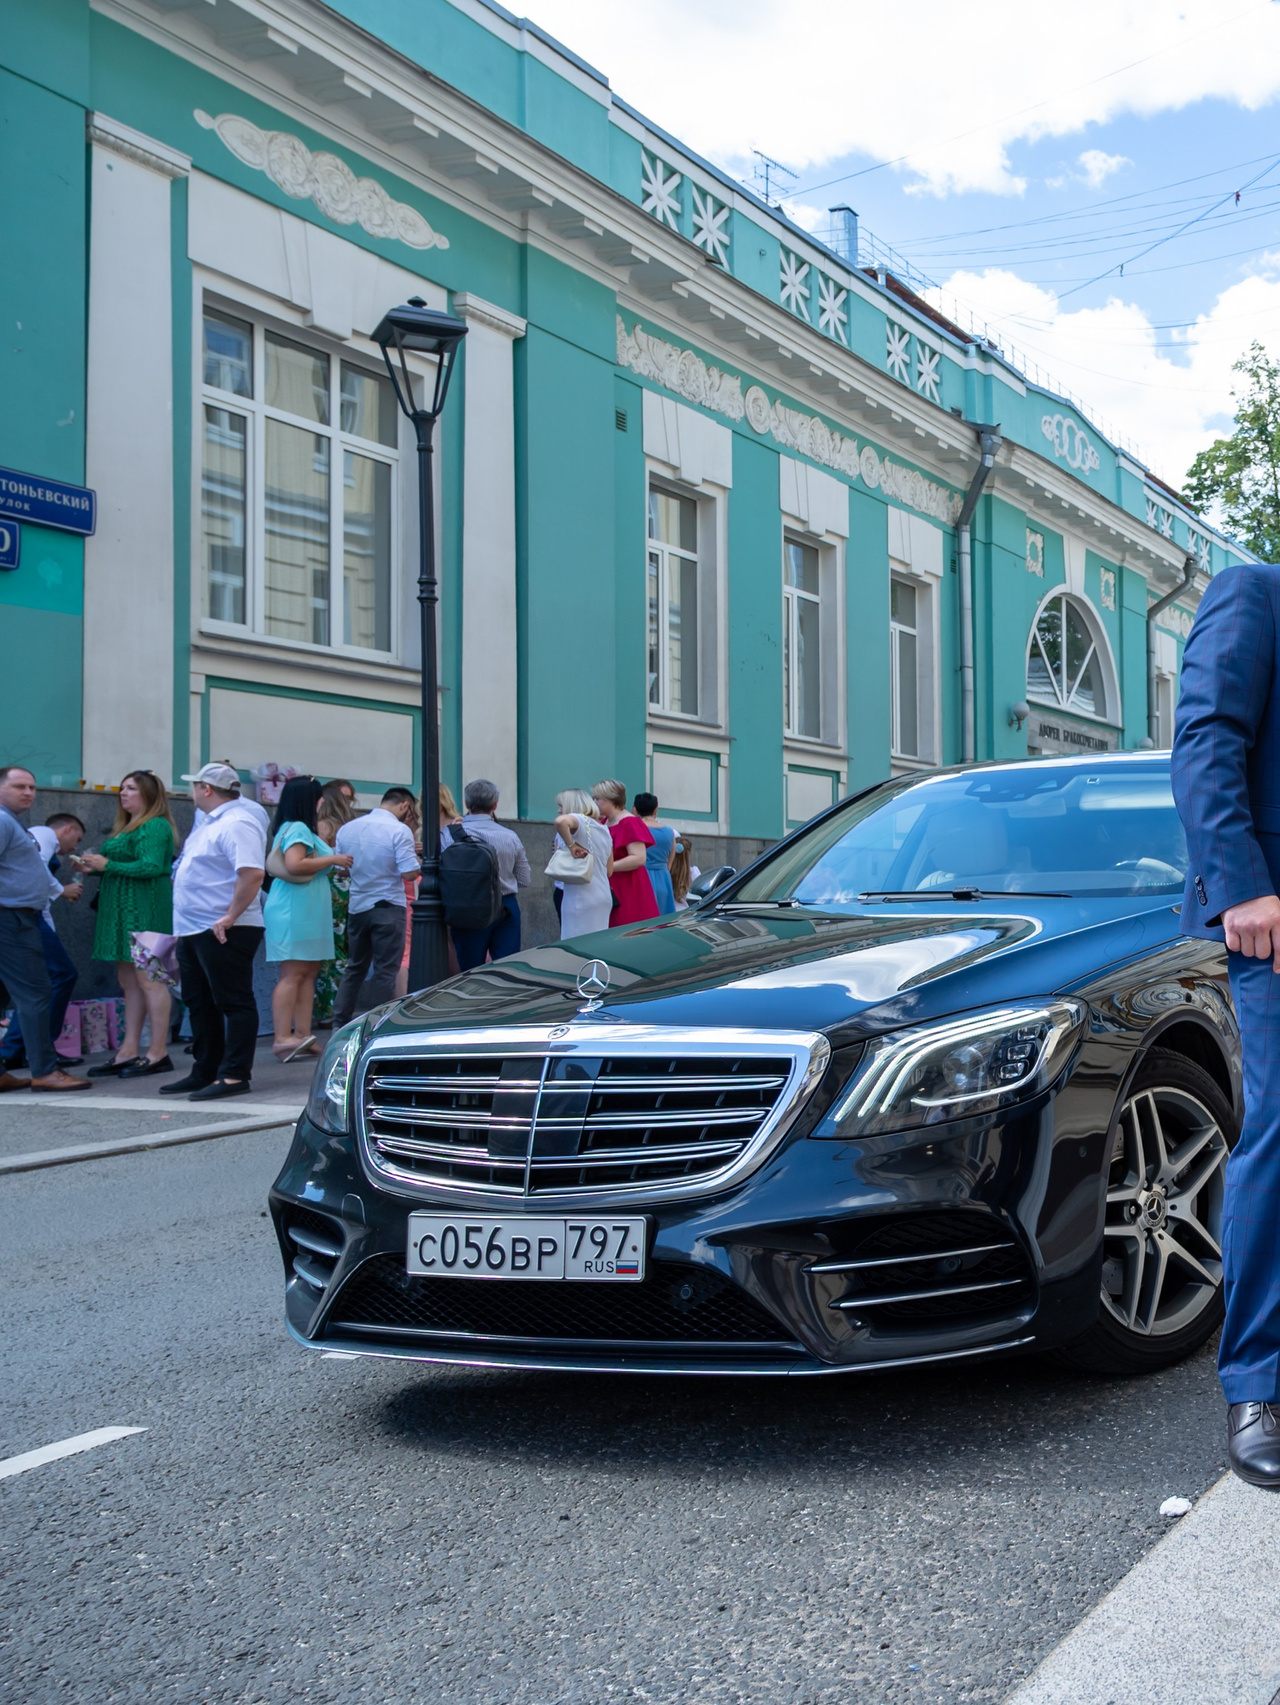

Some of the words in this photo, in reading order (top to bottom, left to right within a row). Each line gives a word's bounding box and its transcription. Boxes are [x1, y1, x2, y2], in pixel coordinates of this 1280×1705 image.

[1039, 723, 1060, 741] ДВОРЕЦ
[418, 1223, 558, 1271] С056ВР
[568, 1225, 631, 1259] 797
[584, 1260, 615, 1273] RUS
